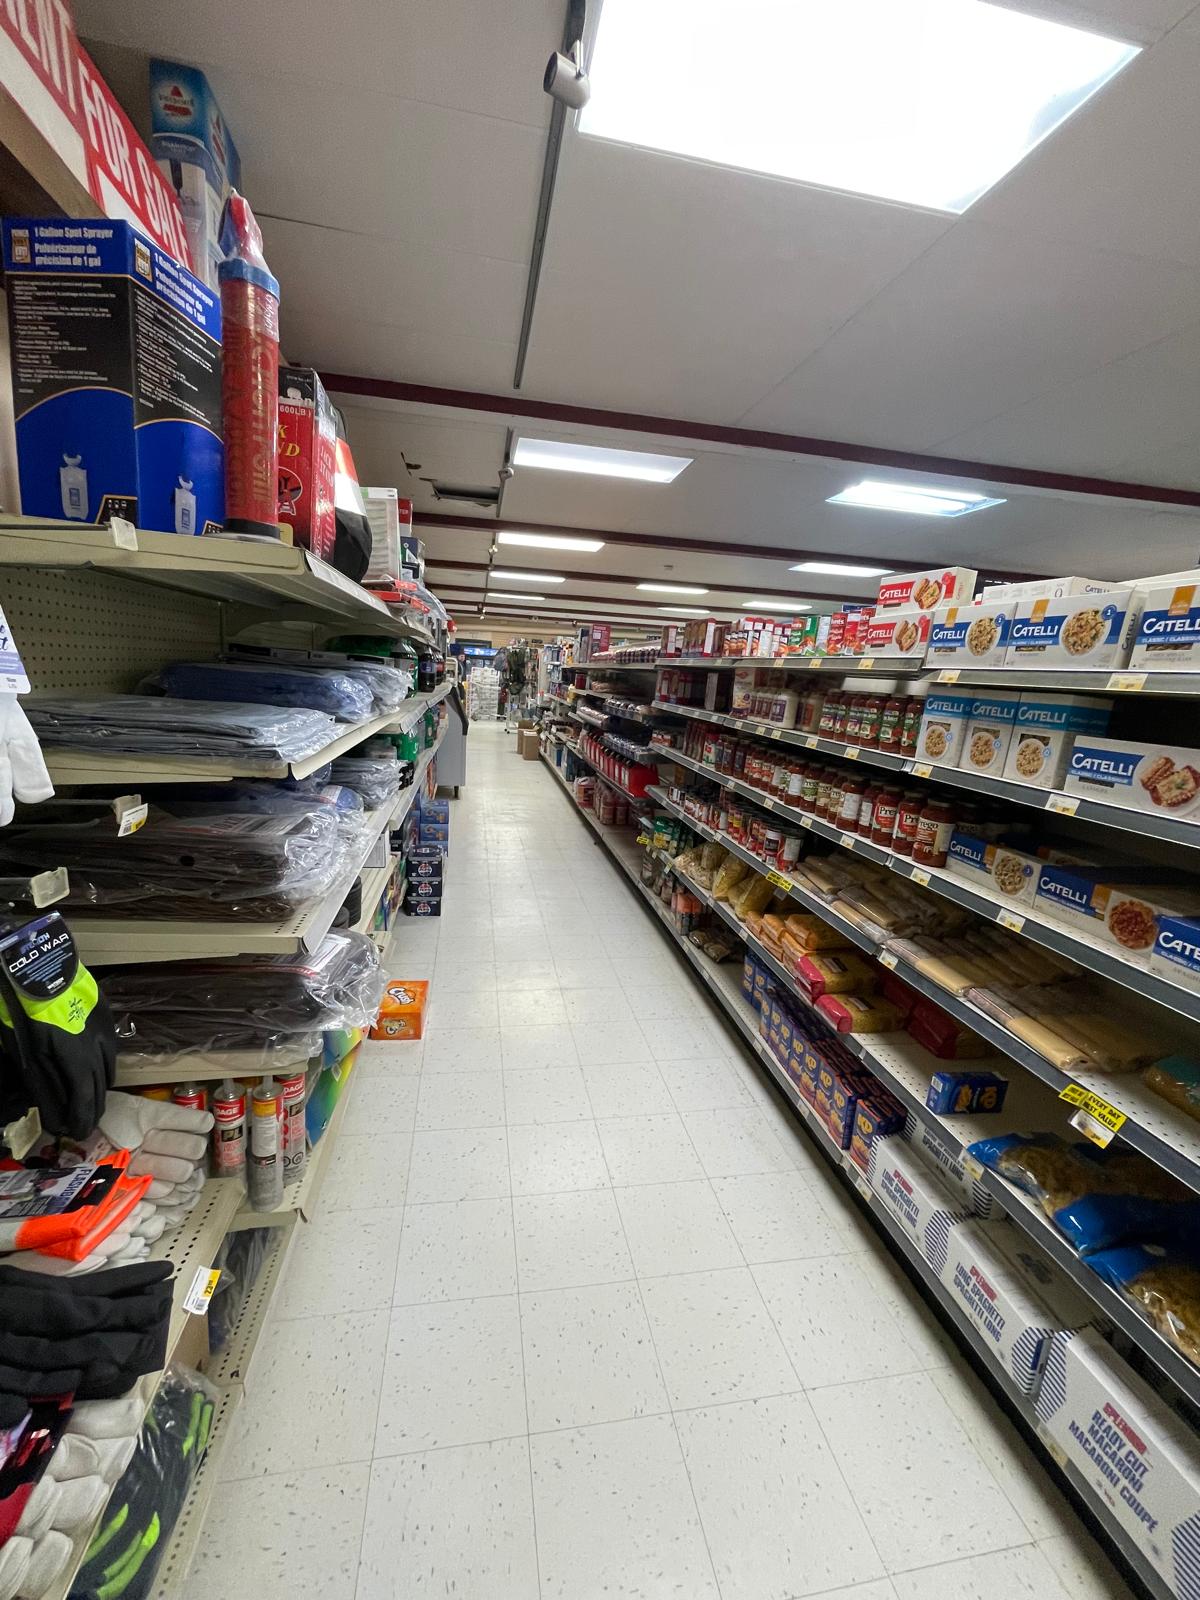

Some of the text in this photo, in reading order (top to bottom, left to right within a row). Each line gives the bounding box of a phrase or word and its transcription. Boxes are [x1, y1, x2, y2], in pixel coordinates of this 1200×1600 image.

[78, 58, 141, 210] FOR
[39, 228, 63, 237] Gallon
[64, 227, 82, 238] Spot
[83, 227, 113, 239] Sprayer
[880, 588, 911, 600] CATELLI
[868, 628, 893, 639] CATELLI
[932, 629, 965, 640] CATELLI
[1013, 625, 1059, 637] CATELLI
[926, 698, 964, 713] CATELLI
[972, 702, 1015, 718] CATELLI
[1018, 707, 1067, 723] CATELLI
[1072, 753, 1134, 776] CATELLI
[880, 806, 897, 816] Pre
[920, 821, 938, 830] rego
[950, 840, 982, 861] CATELLI
[1040, 877, 1087, 905] CATELLI
[9, 950, 39, 973] COLD
[40, 933, 70, 952] WAR
[1088, 1096, 1122, 1121] EVERY DAY
[1098, 1112, 1117, 1129] VALUE
[882, 1168, 920, 1218] LONG SPAGHETTI
[955, 1262, 1006, 1330] LONG SPAGHETTI
[953, 1274, 1002, 1343] SPAGHETTI LONG
[1092, 1409, 1149, 1478] READY CUT
[1087, 1423, 1145, 1493] MACARONI
[1068, 1420, 1159, 1534] MACARONI COUPÉ
